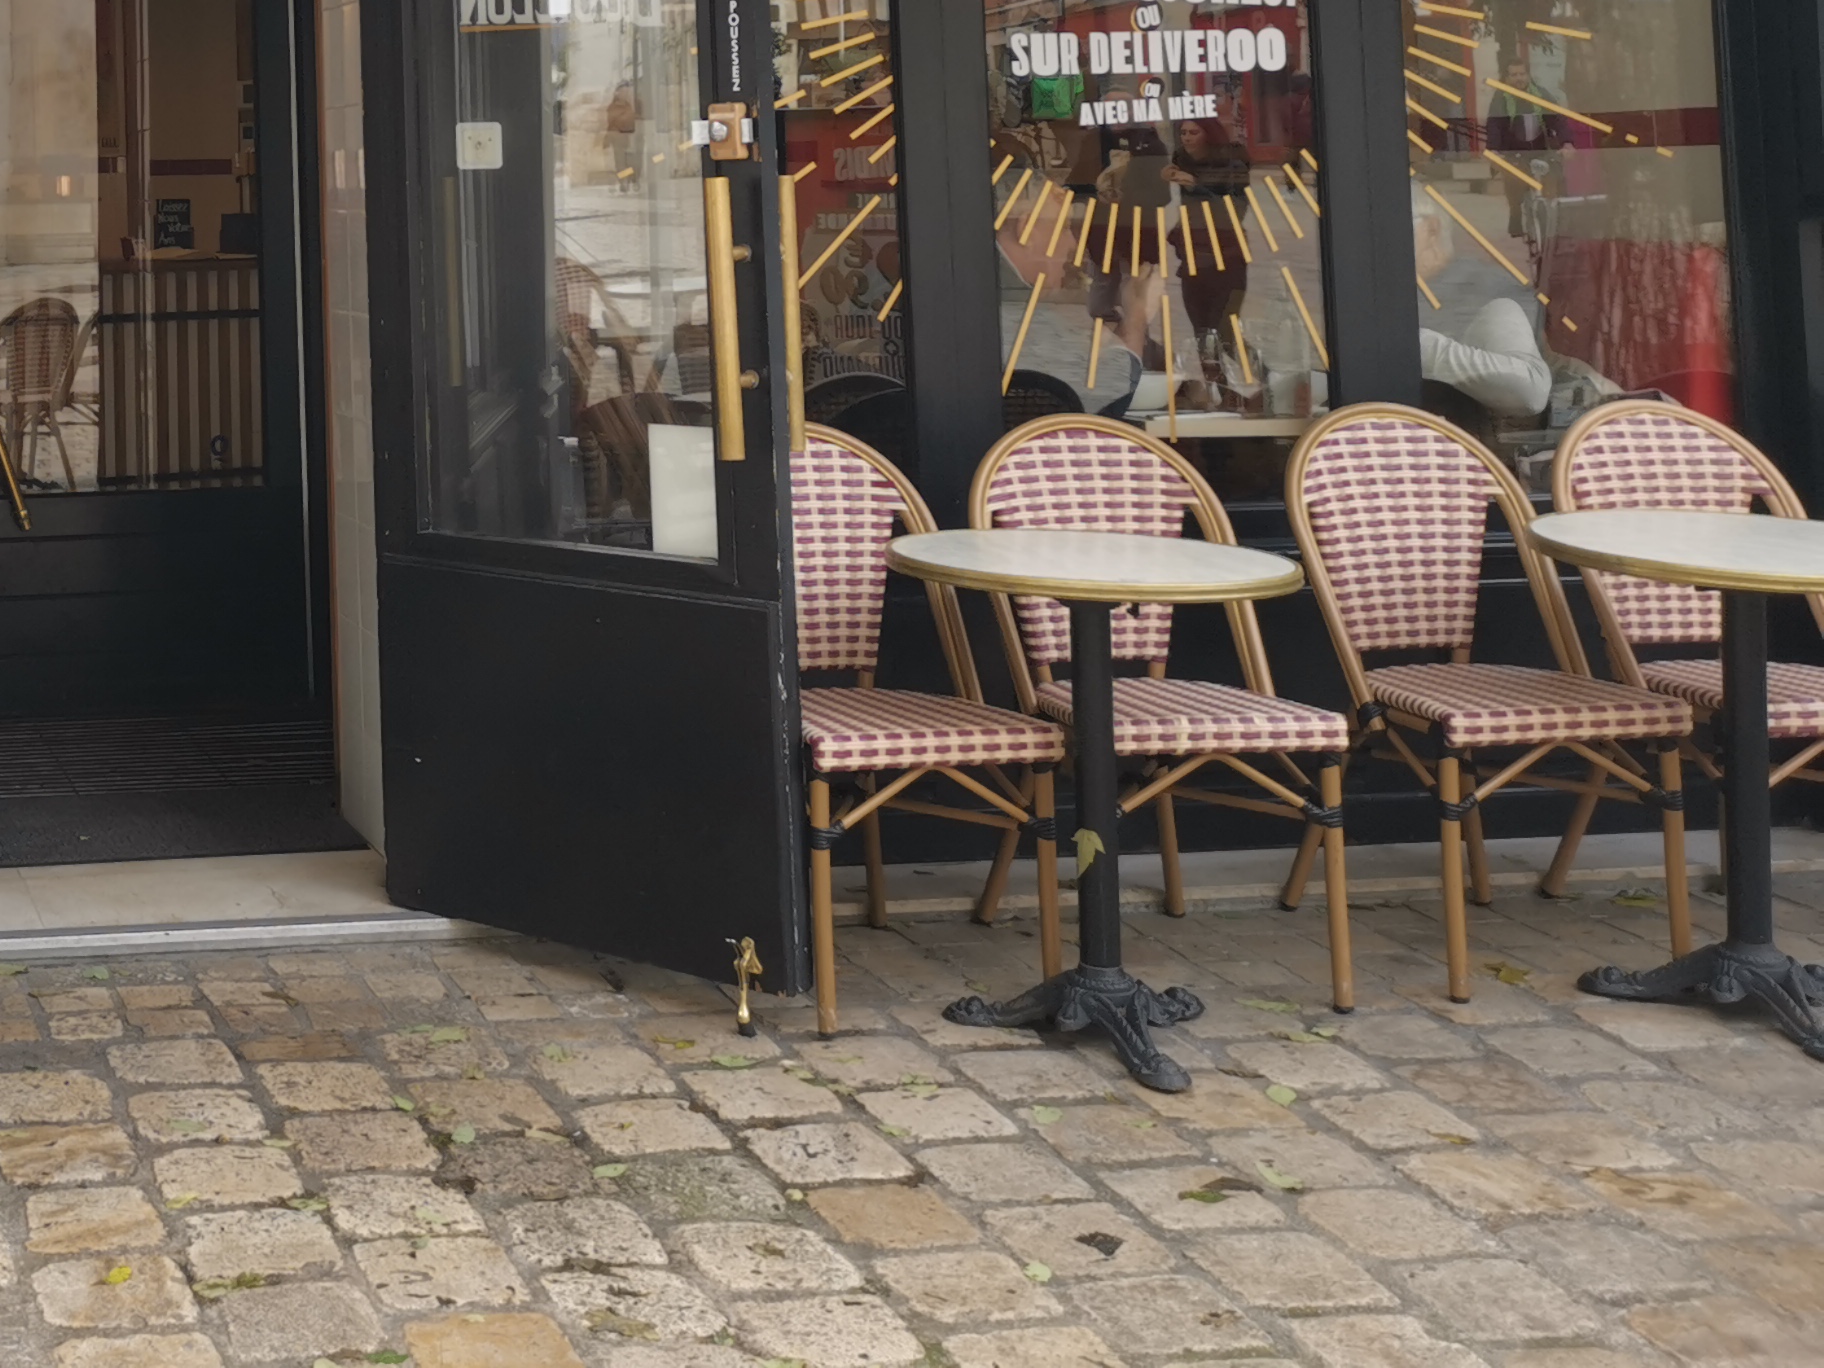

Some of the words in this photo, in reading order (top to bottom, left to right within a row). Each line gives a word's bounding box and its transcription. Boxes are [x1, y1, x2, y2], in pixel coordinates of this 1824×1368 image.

[1136, 5, 1162, 29] OU
[728, 0, 741, 92] POUSSEZ
[1010, 32, 1080, 77] SUR
[1089, 27, 1287, 75] DELIVEROO
[1079, 99, 1129, 126] AVEC
[1132, 98, 1162, 123] MA
[1167, 91, 1218, 120] MÈRE
